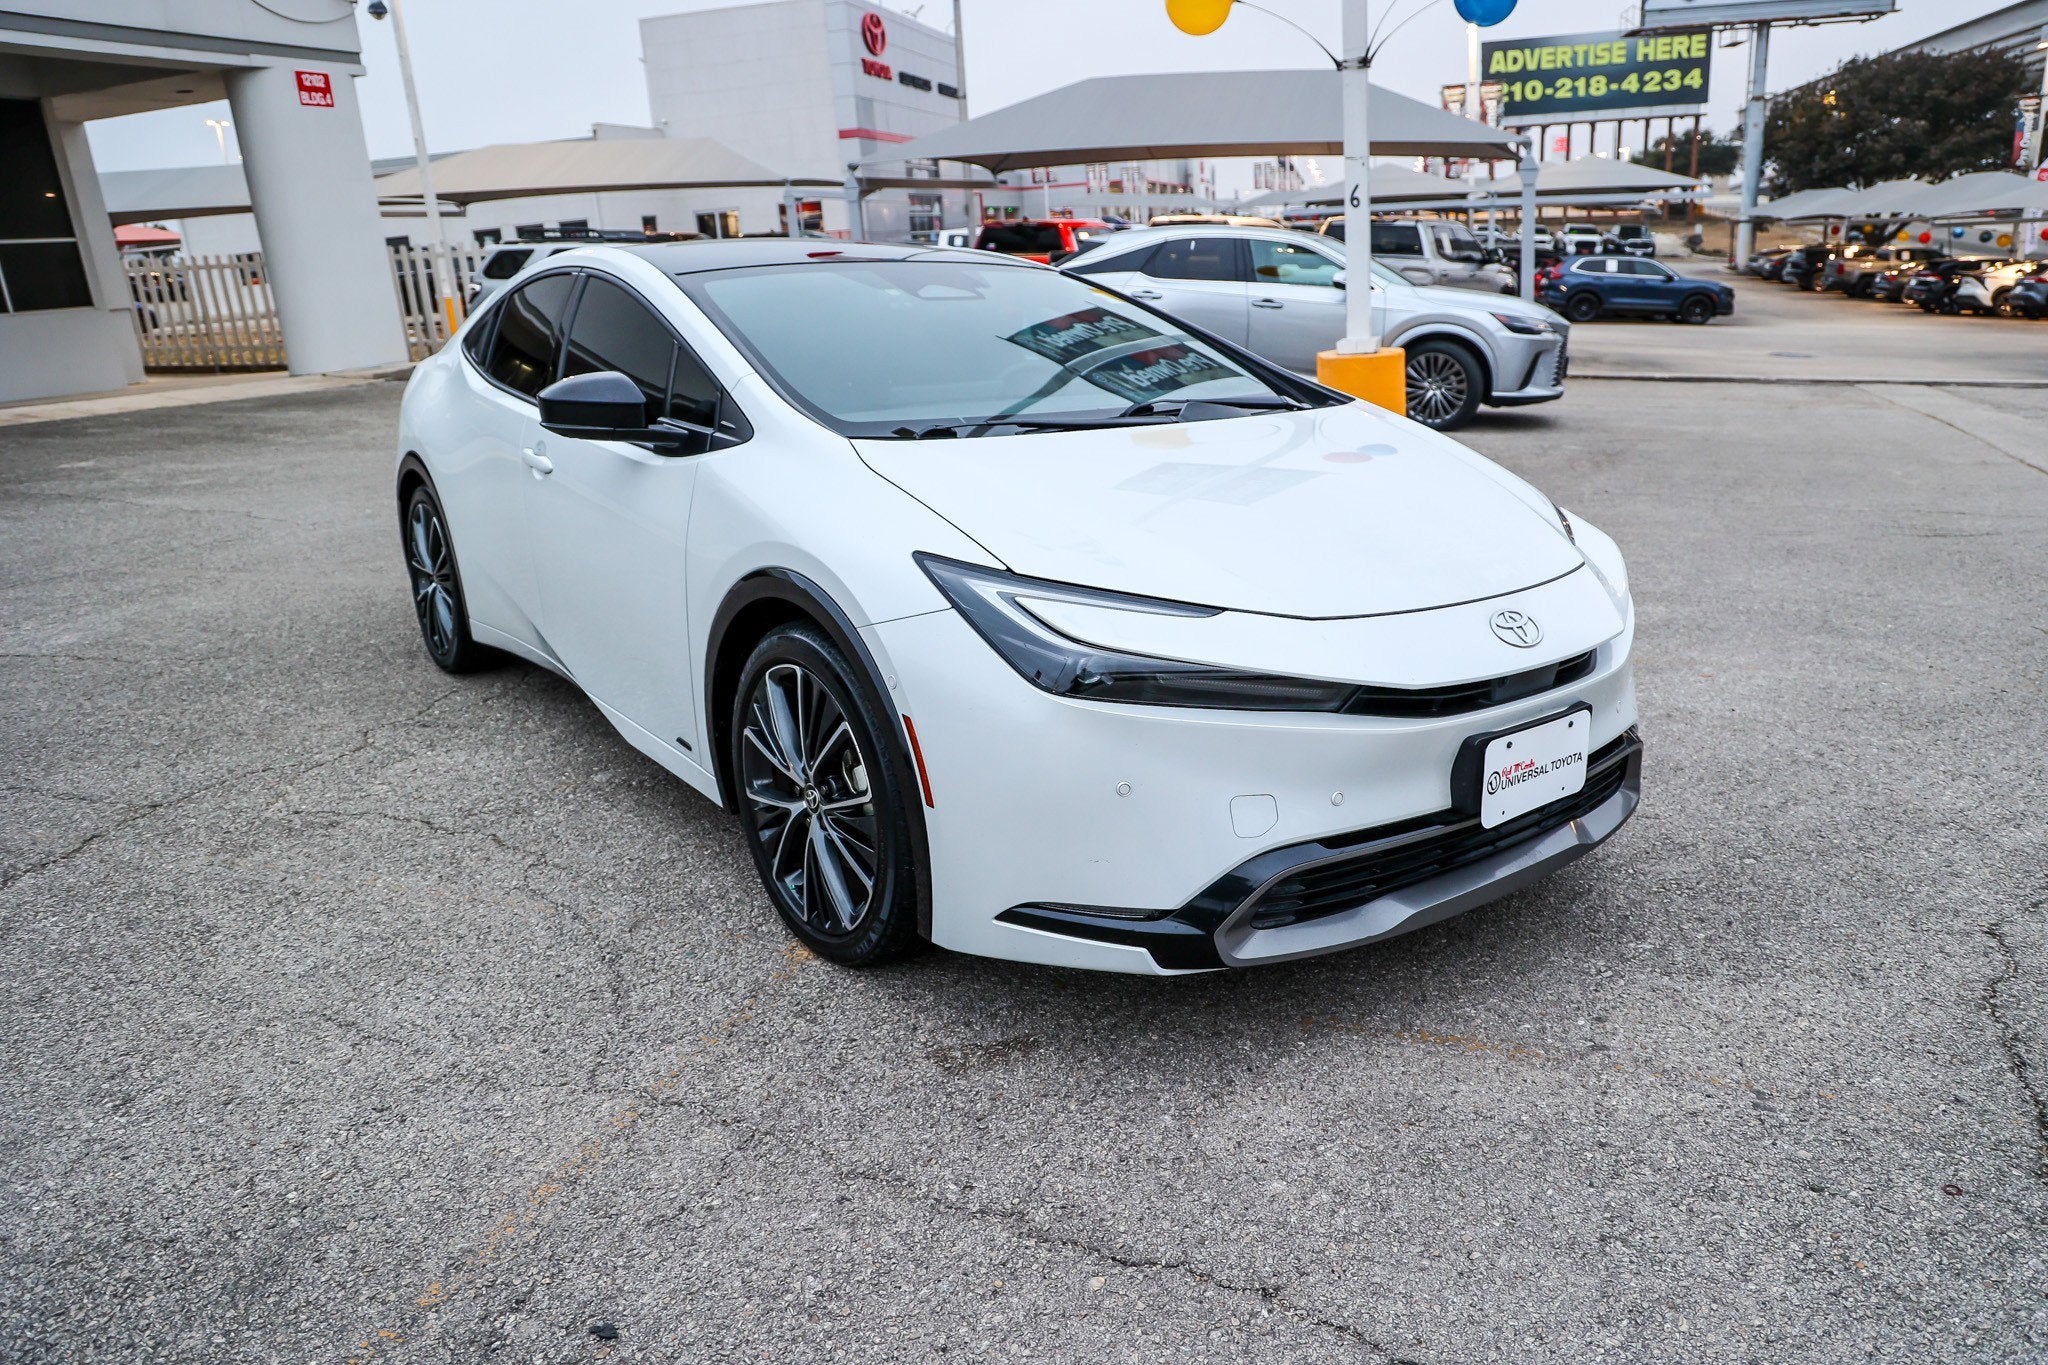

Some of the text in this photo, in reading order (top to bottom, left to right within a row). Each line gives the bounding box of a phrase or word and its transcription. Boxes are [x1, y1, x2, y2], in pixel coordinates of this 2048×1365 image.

[1489, 33, 1708, 74] ADVERTISE HERE
[1350, 184, 1360, 208] 6
[1501, 765, 1550, 790] UNIVERSAL
[1551, 752, 1583, 772] TOYOTA
